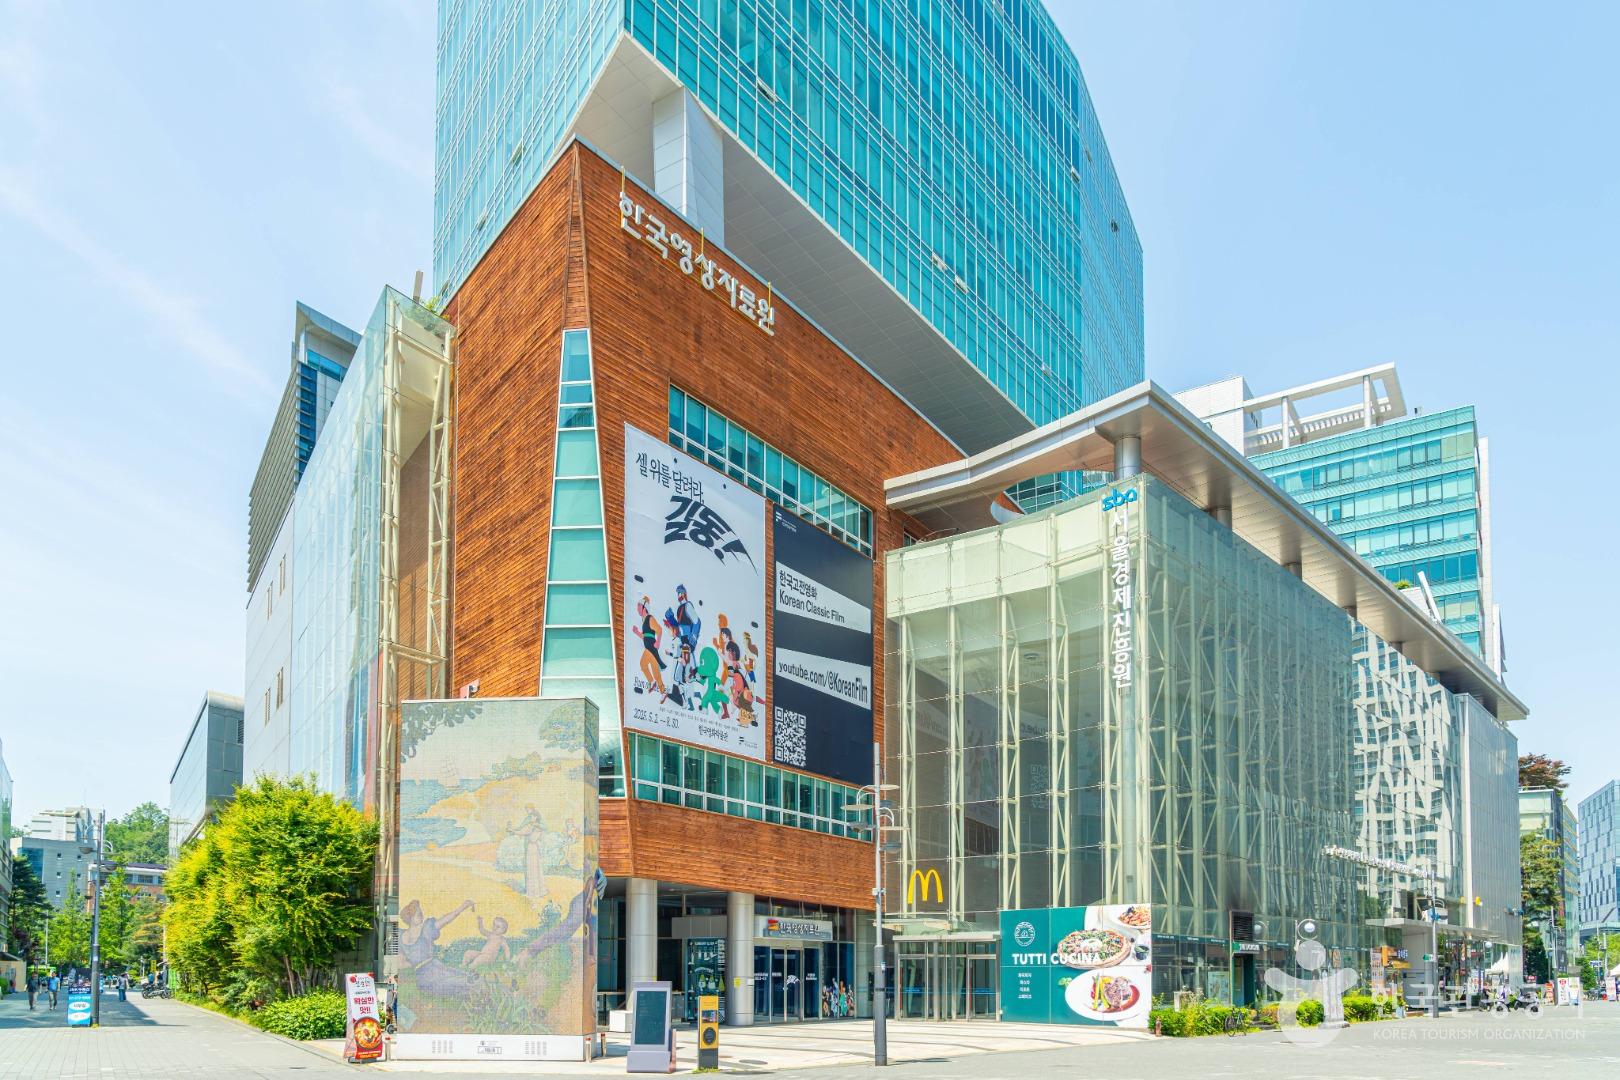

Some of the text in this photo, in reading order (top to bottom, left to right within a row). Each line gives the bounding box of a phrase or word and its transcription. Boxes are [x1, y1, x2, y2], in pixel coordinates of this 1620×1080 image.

[619, 191, 775, 336] 한국영상자료원
[1102, 488, 1138, 511] sba
[779, 570, 818, 600] 한국고전영화
[1110, 510, 1133, 688] 서울경제진흥원
[779, 589, 845, 623] Korean Classic Film
[778, 660, 868, 703] youtube.com/@KoreanFilm
[780, 922, 820, 936] 한국영상자료원
[1012, 953, 1102, 965] TUTTI CUCINA
